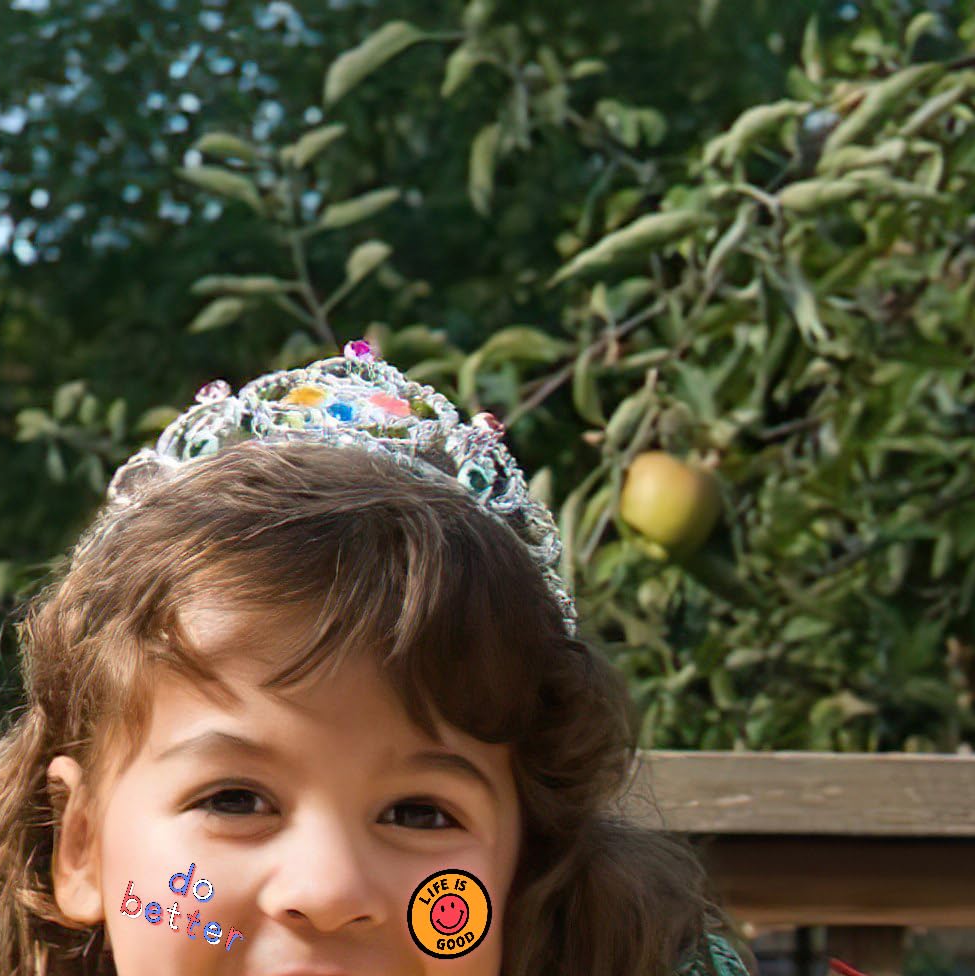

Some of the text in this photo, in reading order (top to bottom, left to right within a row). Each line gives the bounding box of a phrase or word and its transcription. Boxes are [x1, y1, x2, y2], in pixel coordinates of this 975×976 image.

[169, 862, 215, 902] do
[418, 879, 467, 905] LIFE IS
[120, 880, 244, 951] better
[436, 931, 475, 950] GOOD
